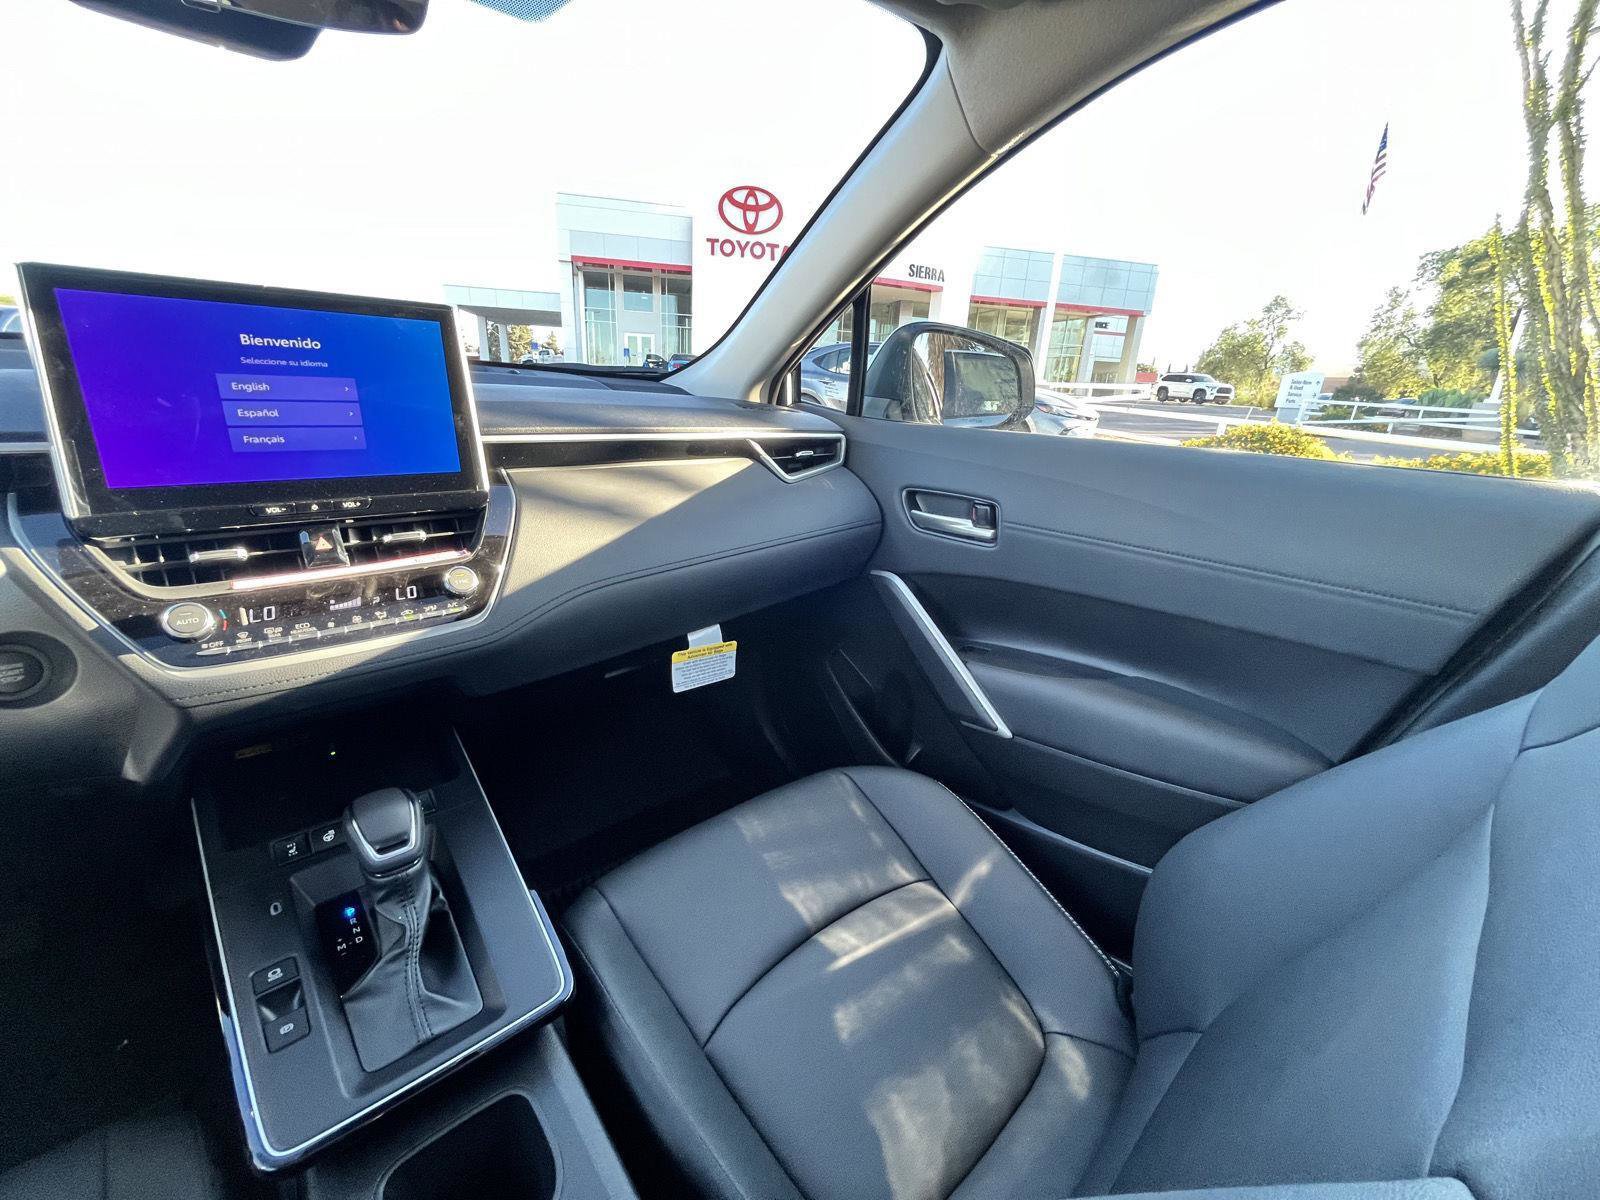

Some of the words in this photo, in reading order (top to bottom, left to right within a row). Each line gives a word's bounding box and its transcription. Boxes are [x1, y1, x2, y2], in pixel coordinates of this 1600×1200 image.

[909, 264, 945, 282] SIERRA
[239, 333, 321, 350] Bienvenido
[240, 357, 287, 366] Seleccione
[300, 359, 329, 368] idioma
[231, 382, 270, 393] English
[237, 408, 280, 418] Español
[243, 435, 285, 445] Français
[395, 585, 417, 601] LO
[249, 606, 276, 623] LO
[176, 617, 199, 626] AUTO
[295, 622, 310, 630] ECO
[208, 640, 224, 648] OFF
[355, 936, 363, 944] D
[337, 943, 347, 951] M
